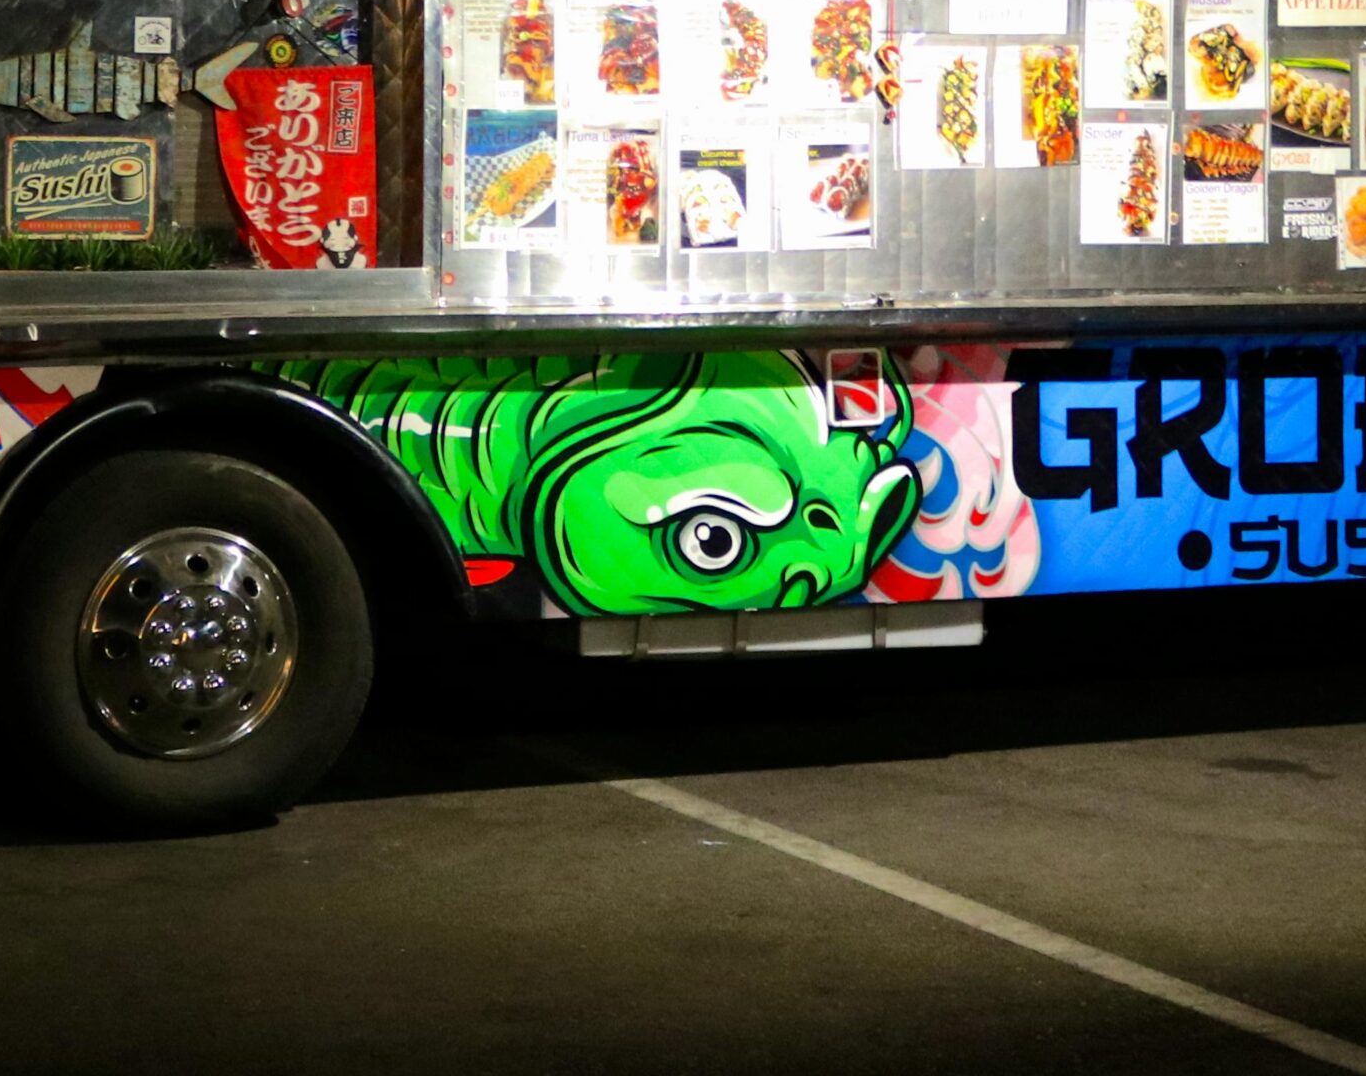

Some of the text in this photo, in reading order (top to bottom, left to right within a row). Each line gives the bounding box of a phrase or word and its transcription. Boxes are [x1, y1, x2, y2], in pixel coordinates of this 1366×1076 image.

[336, 87, 360, 147] ご来店
[572, 131, 599, 142] Tuna
[1084, 126, 1124, 141] Spider
[15, 143, 140, 174] Authentic Japanese
[274, 79, 325, 247] ありがとう
[14, 164, 109, 206] Sushi
[1185, 182, 1259, 197] Golden Dragon
